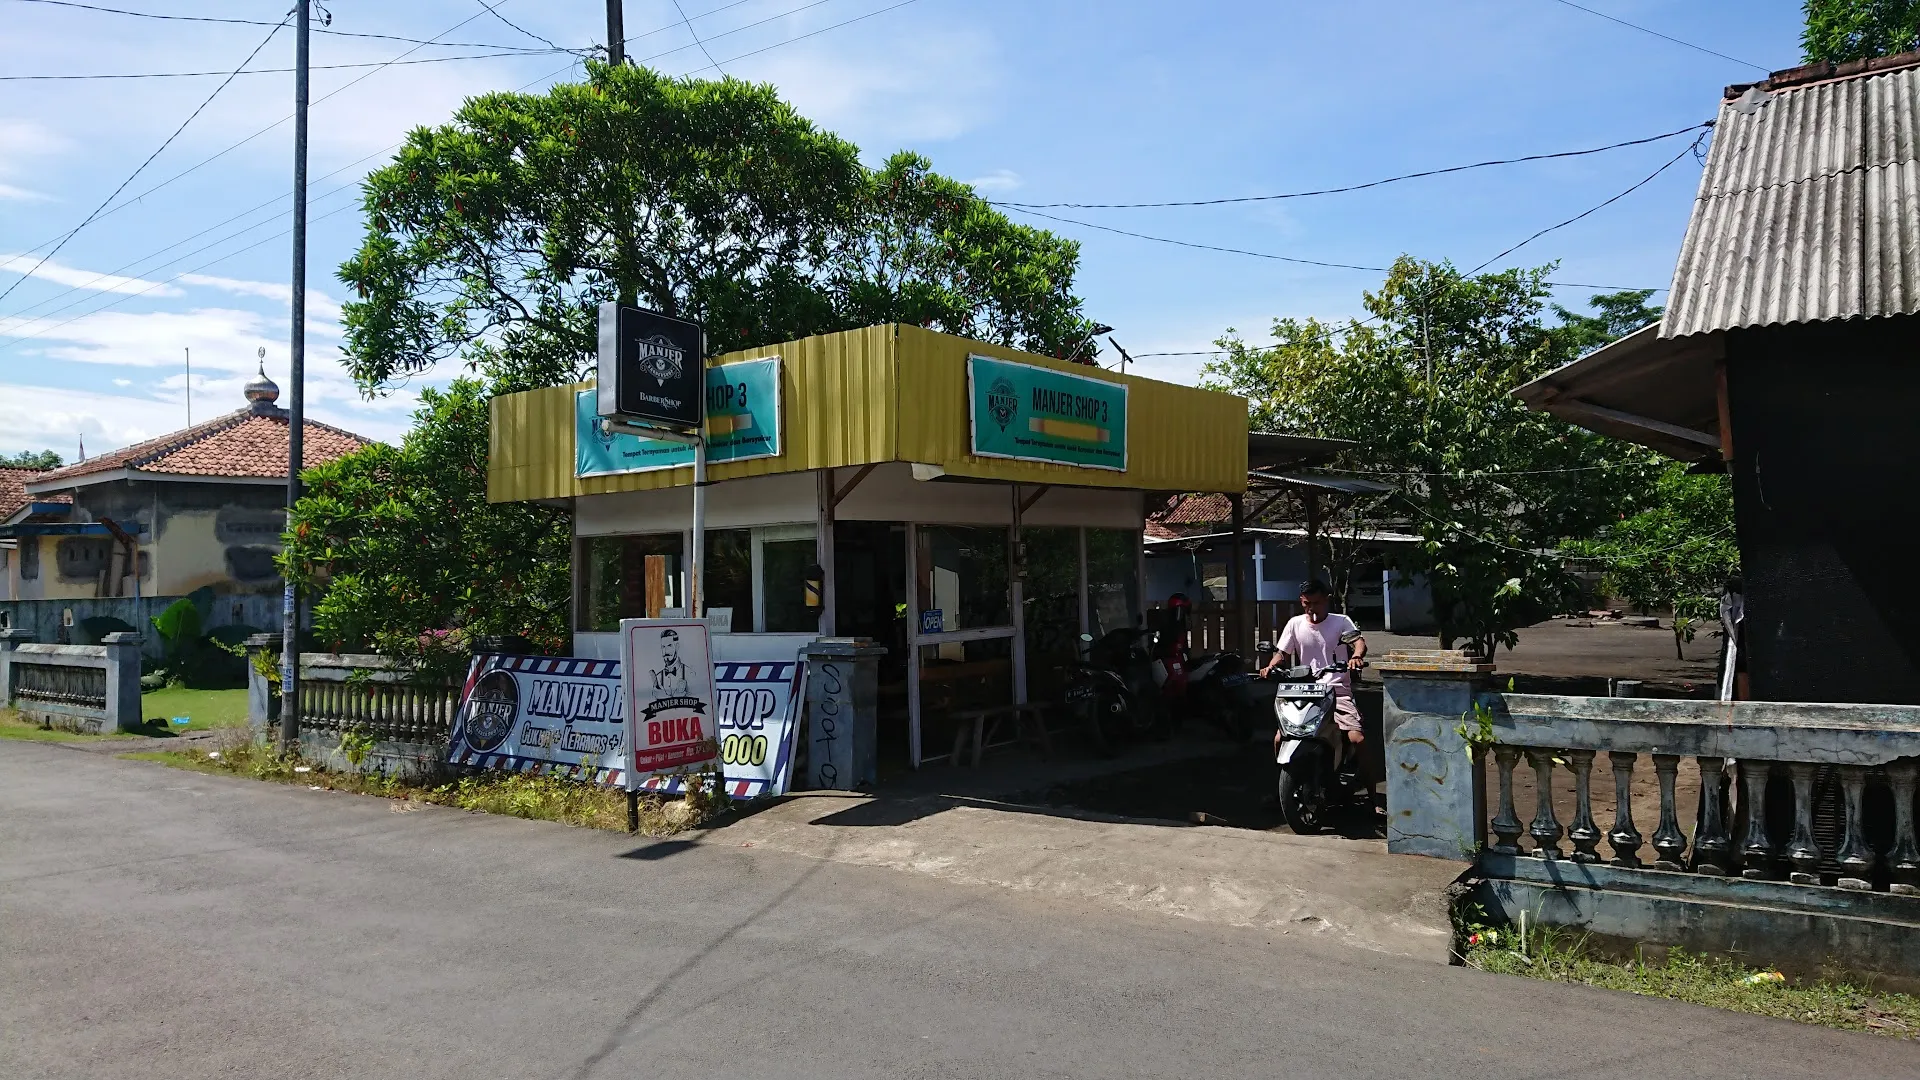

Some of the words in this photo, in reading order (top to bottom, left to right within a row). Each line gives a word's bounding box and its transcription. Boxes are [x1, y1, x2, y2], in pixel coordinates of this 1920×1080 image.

[639, 342, 683, 370] MANJER
[707, 384, 734, 411] HOP
[738, 382, 747, 408] 3
[989, 395, 1018, 415] MANJER
[1032, 387, 1072, 416] MANJER
[1075, 396, 1099, 420] SHOP
[1101, 401, 1108, 423] 3
[925, 616, 942, 629] OPEN
[468, 701, 512, 726] MANJER
[527, 680, 610, 723] MANJER
[650, 699, 679, 711] MANJER
[680, 698, 698, 706] SHOP
[717, 689, 776, 730] HOP
[648, 717, 703, 745] BUKA
[722, 734, 768, 766] 000
